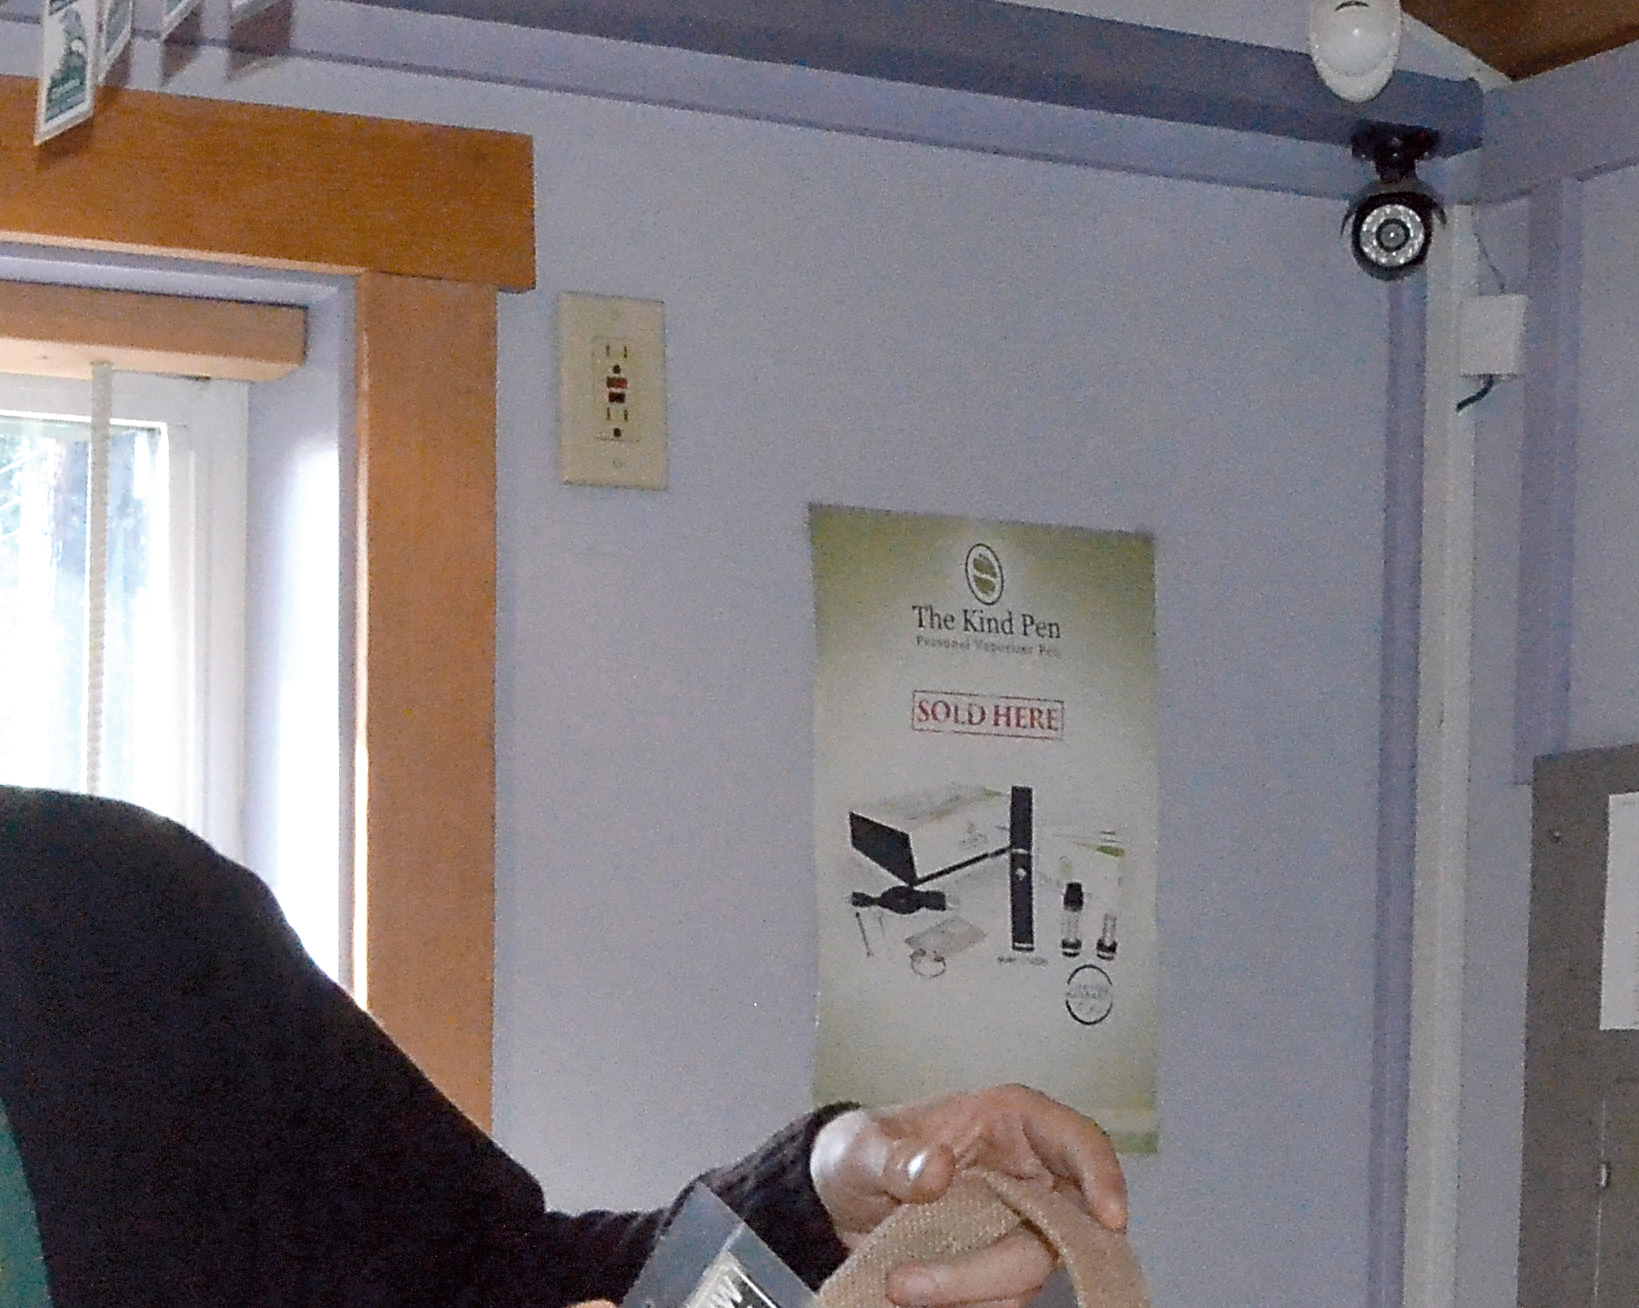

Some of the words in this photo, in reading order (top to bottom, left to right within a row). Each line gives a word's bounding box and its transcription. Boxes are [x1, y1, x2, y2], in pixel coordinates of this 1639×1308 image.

[912, 605, 955, 630] The
[963, 609, 1013, 635] Kind
[1021, 613, 1061, 639] Pen
[917, 699, 986, 726] SOLD
[993, 704, 1059, 731] HERE
